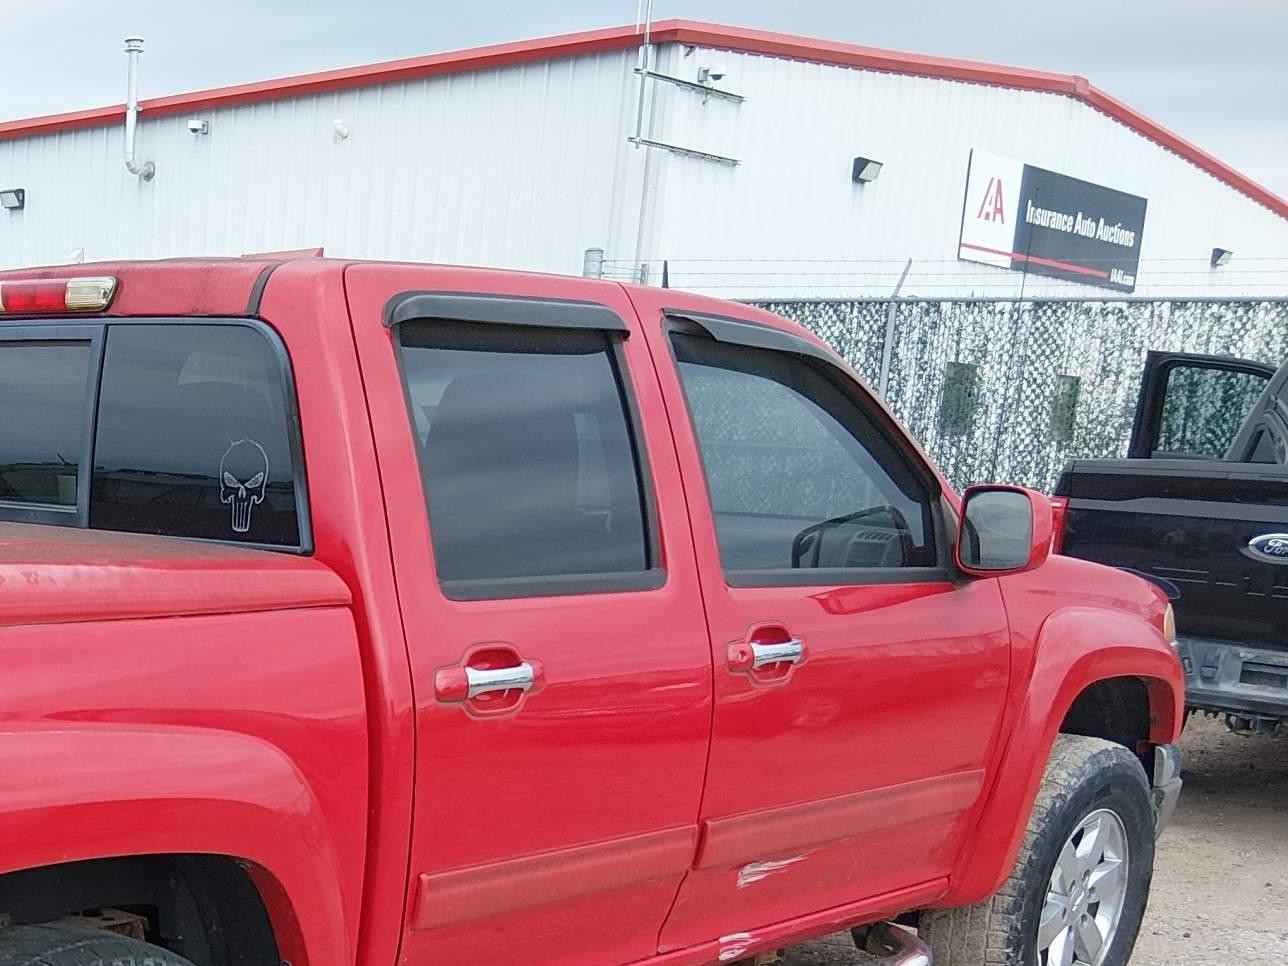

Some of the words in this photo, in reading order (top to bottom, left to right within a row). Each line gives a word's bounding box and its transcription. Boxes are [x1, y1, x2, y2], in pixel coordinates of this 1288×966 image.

[1025, 199, 1074, 233] Insurance
[1073, 211, 1096, 239] Auto
[1095, 217, 1135, 248] Auctions
[1263, 538, 1288, 555] For
